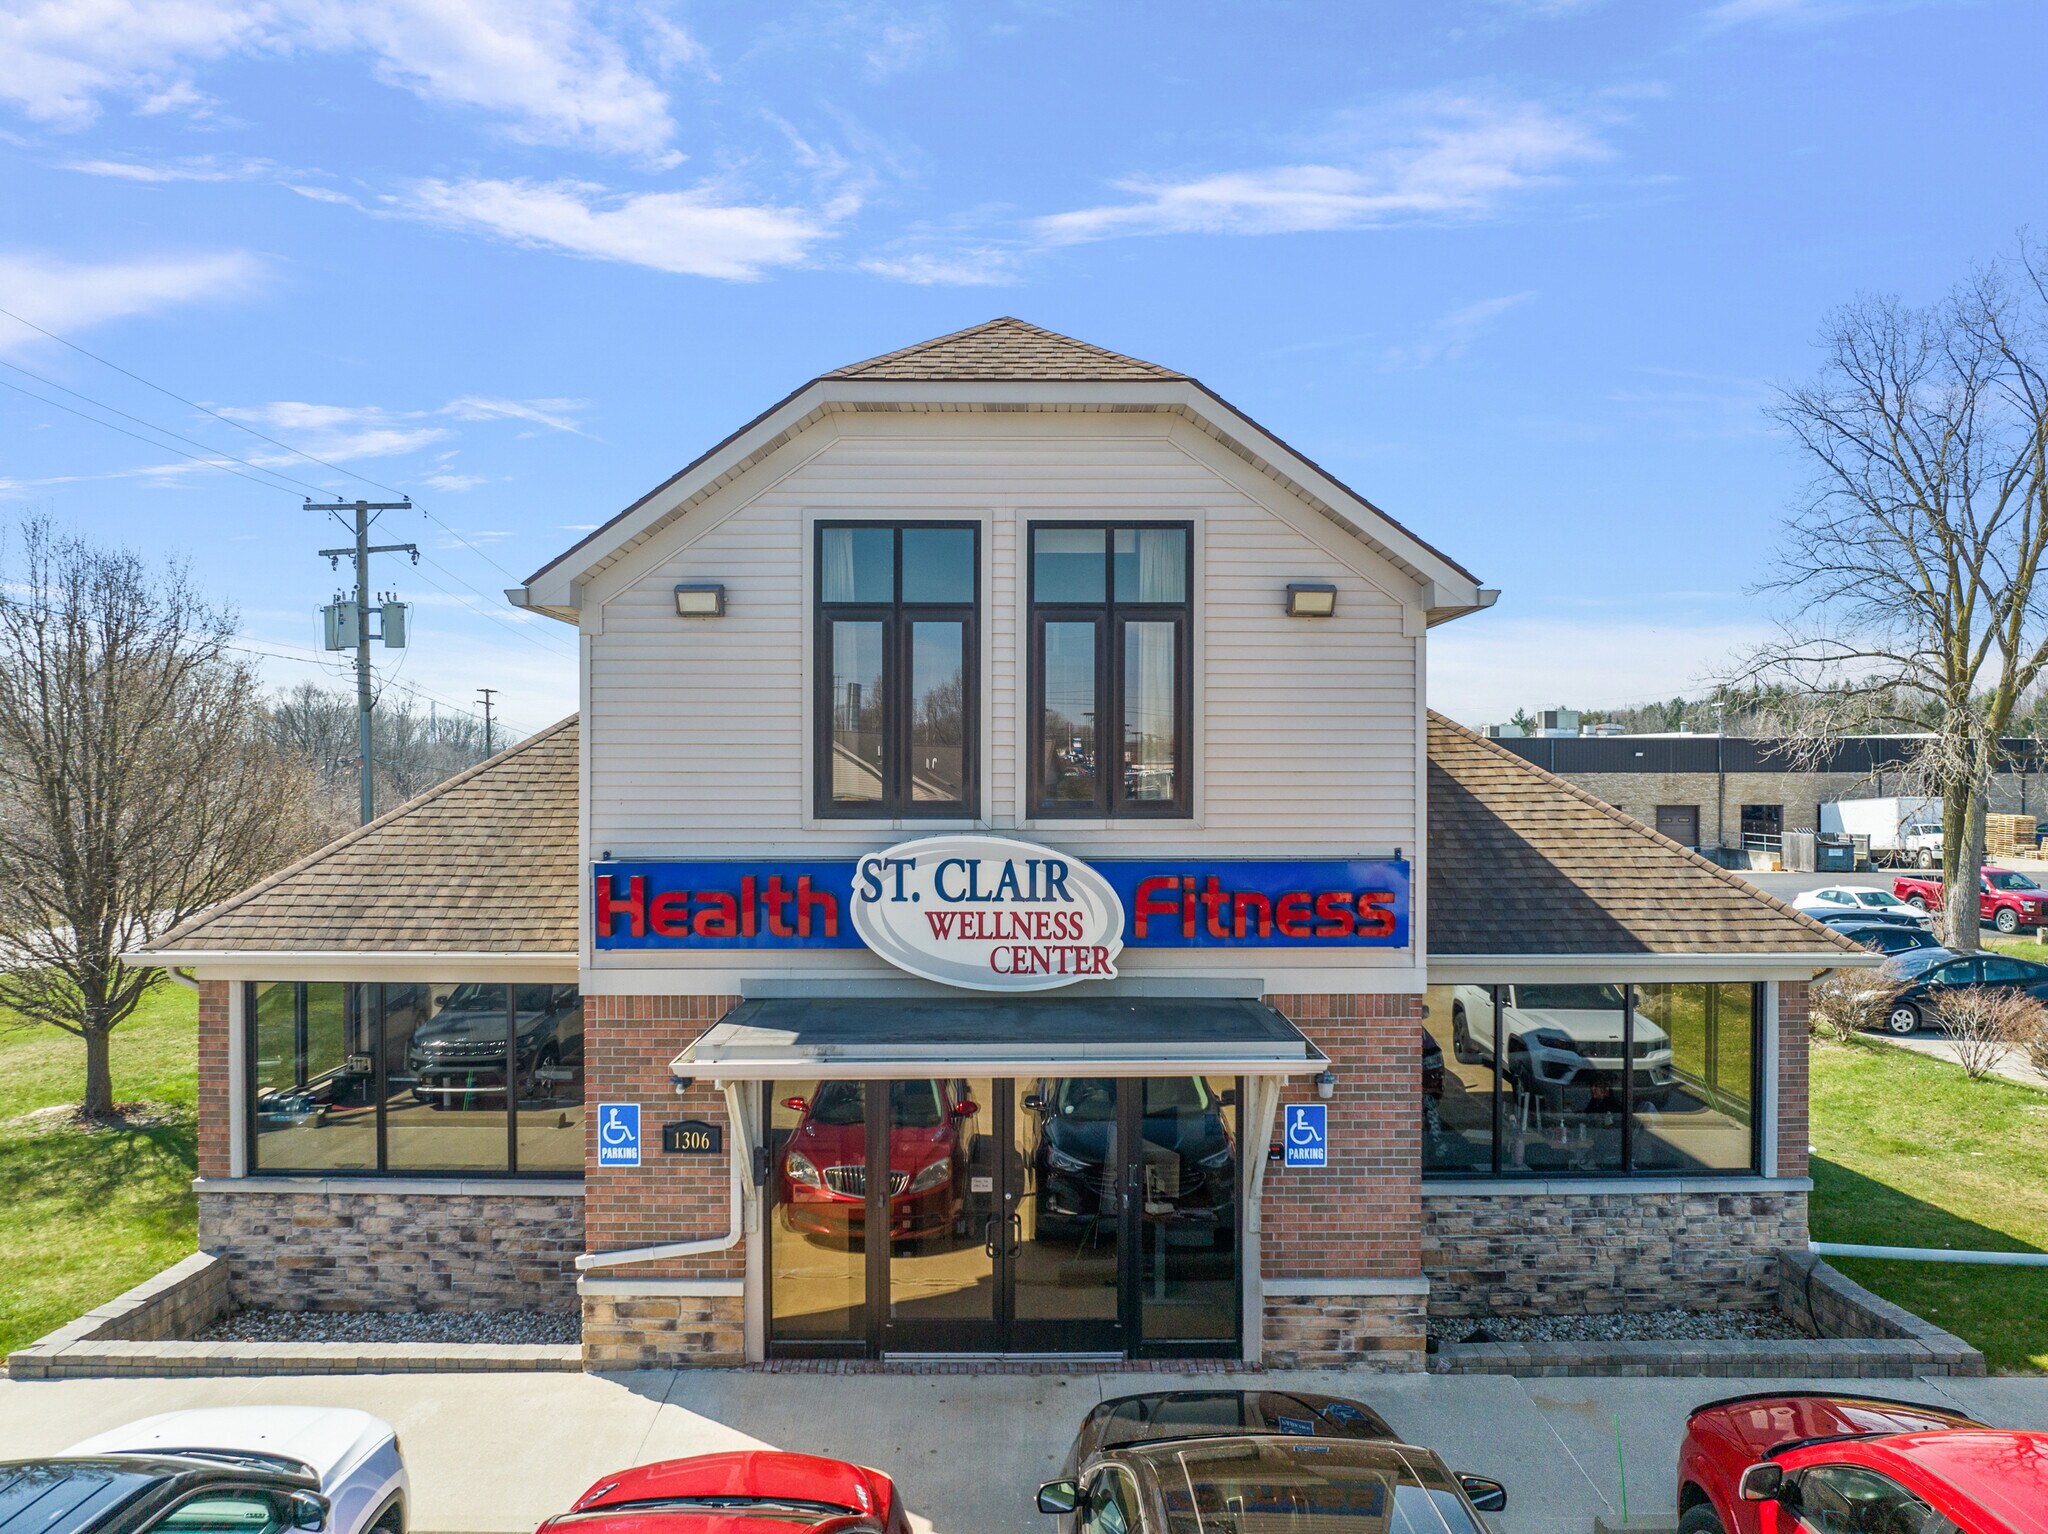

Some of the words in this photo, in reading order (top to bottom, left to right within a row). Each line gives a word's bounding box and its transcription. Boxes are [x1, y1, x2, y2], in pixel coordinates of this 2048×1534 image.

[860, 858, 920, 903] ST.
[934, 858, 1074, 903] CLAIR
[597, 874, 838, 938] Health
[1134, 874, 1396, 938] Fitness
[924, 911, 1084, 941] WELLNESS
[989, 945, 1113, 975] CENTER
[601, 1147, 638, 1159] PARKING
[674, 1131, 710, 1150] 1306
[1288, 1147, 1324, 1160] PARKING
